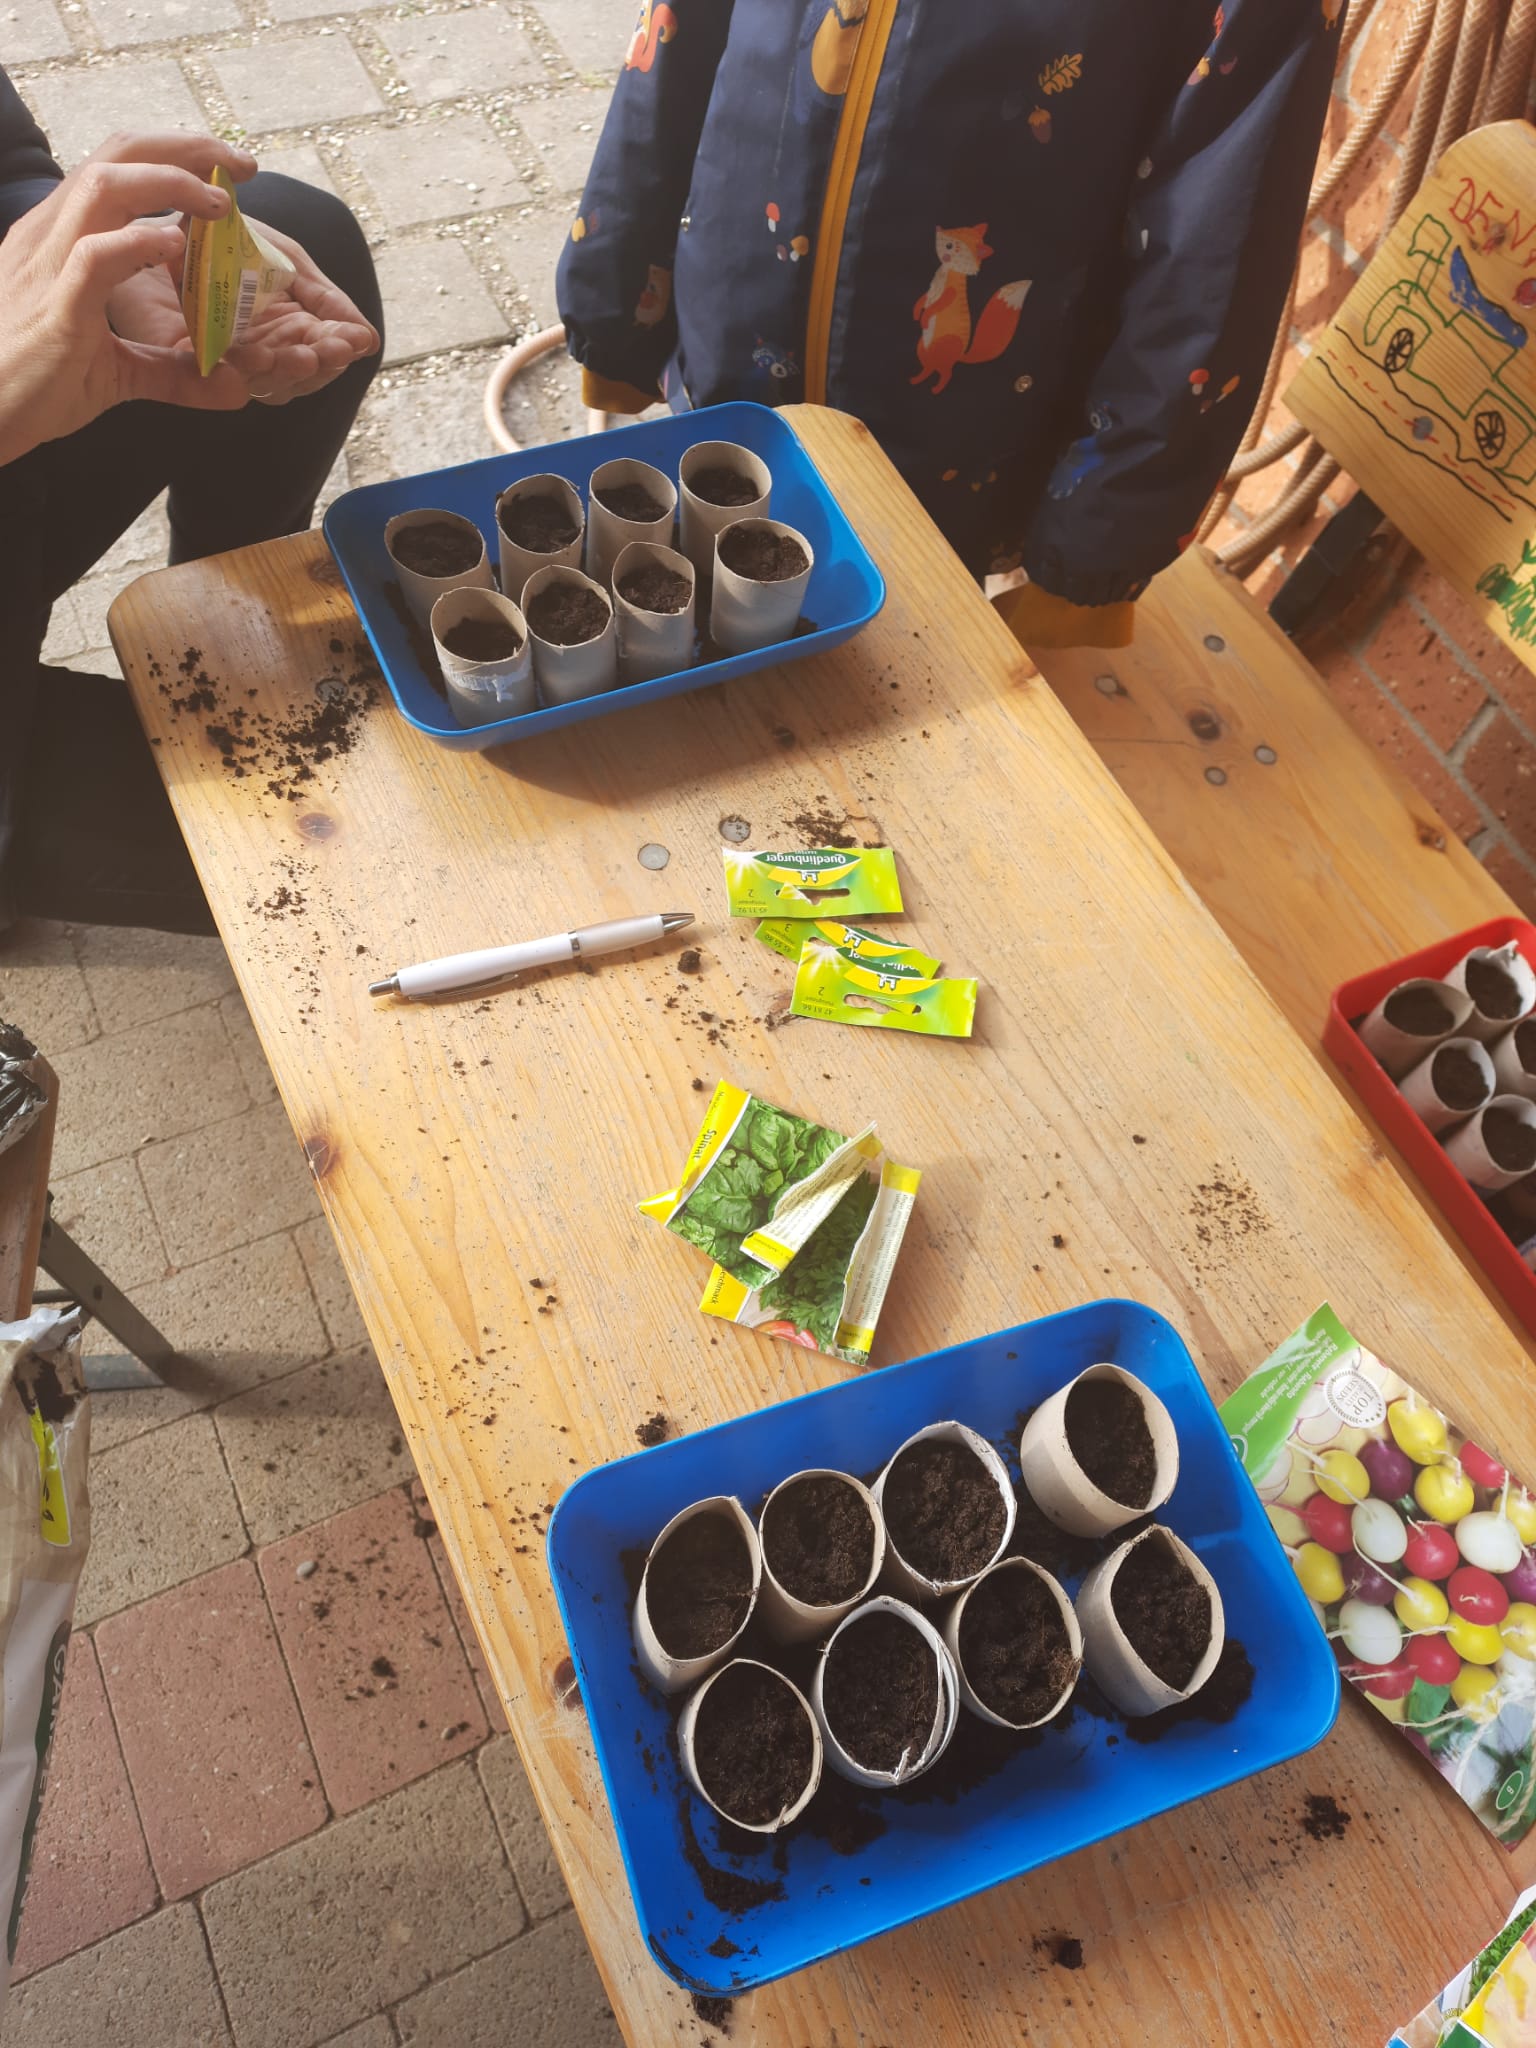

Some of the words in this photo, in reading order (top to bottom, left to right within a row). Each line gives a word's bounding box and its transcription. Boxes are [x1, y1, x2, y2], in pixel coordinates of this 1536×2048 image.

[766, 853, 846, 865] Quedlinburger
[818, 986, 825, 996] 2
[693, 1129, 717, 1158] Spinat
[1353, 1391, 1374, 1416] TOP
